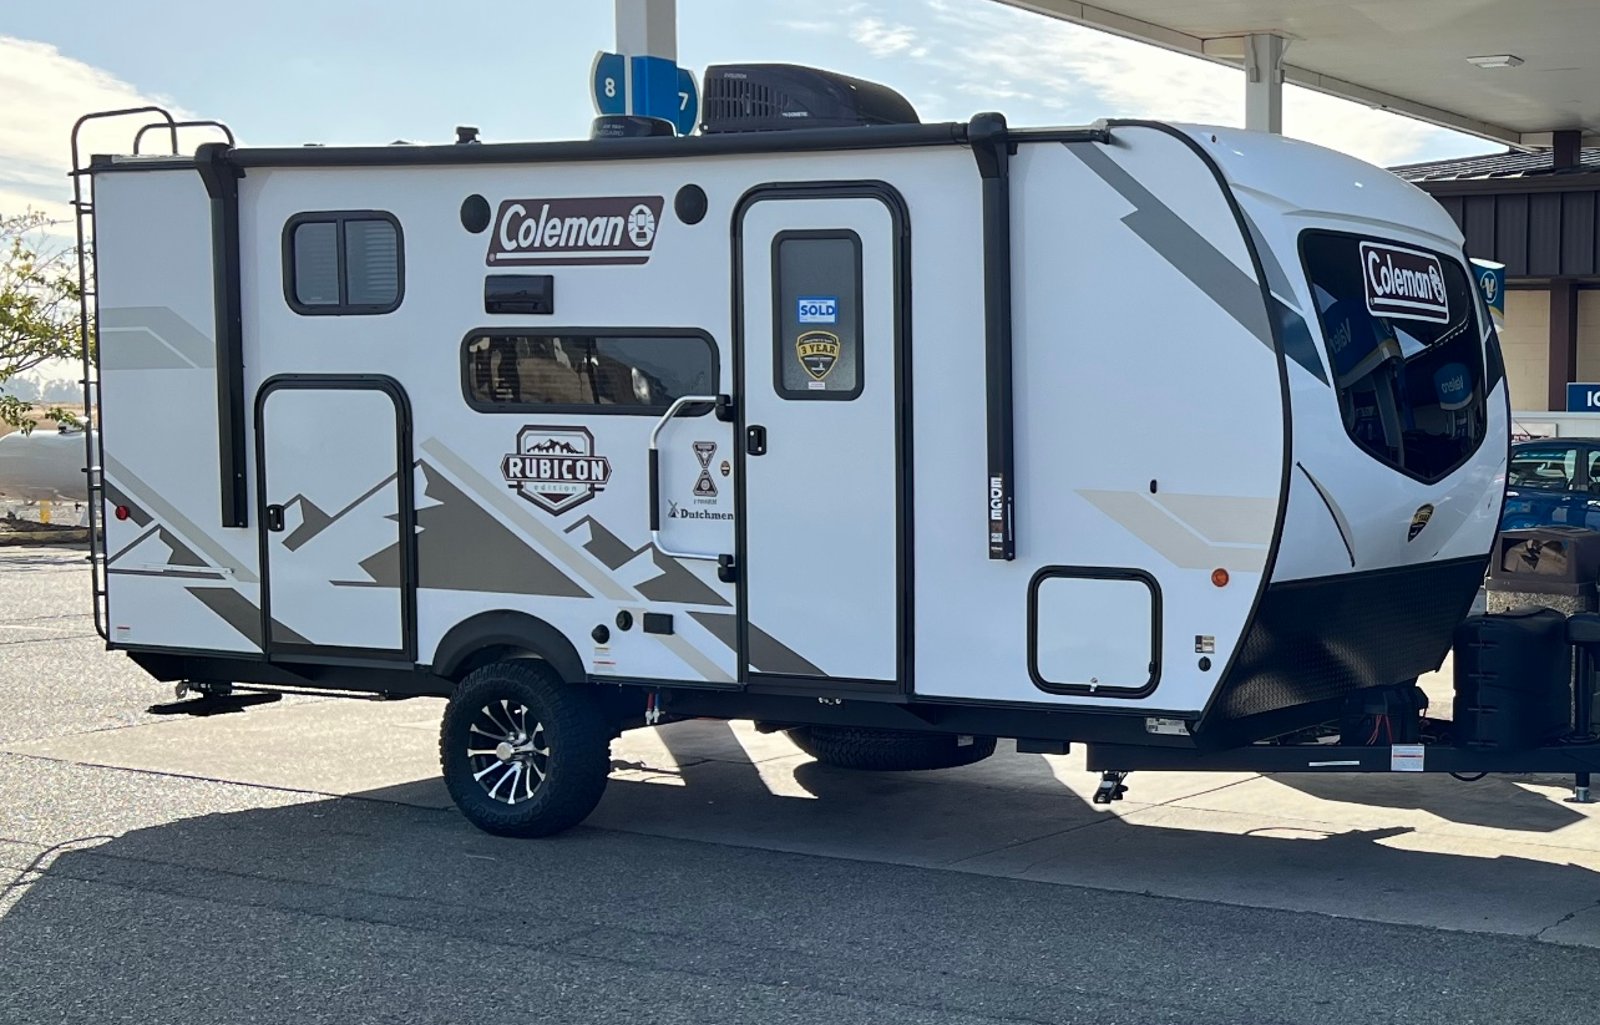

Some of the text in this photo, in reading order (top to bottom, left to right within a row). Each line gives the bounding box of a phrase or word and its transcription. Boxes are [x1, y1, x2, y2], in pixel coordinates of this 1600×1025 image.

[604, 77, 616, 98] 8
[678, 91, 689, 111] 7
[500, 203, 625, 251] Coleman
[1367, 250, 1433, 300] Coleman
[800, 304, 836, 316] SOLD
[800, 343, 836, 355] 3 YEAR
[508, 457, 605, 481] RUBICON
[534, 485, 578, 493] edition
[990, 476, 1003, 520] EDGE
[680, 508, 734, 520] Dutchmen
